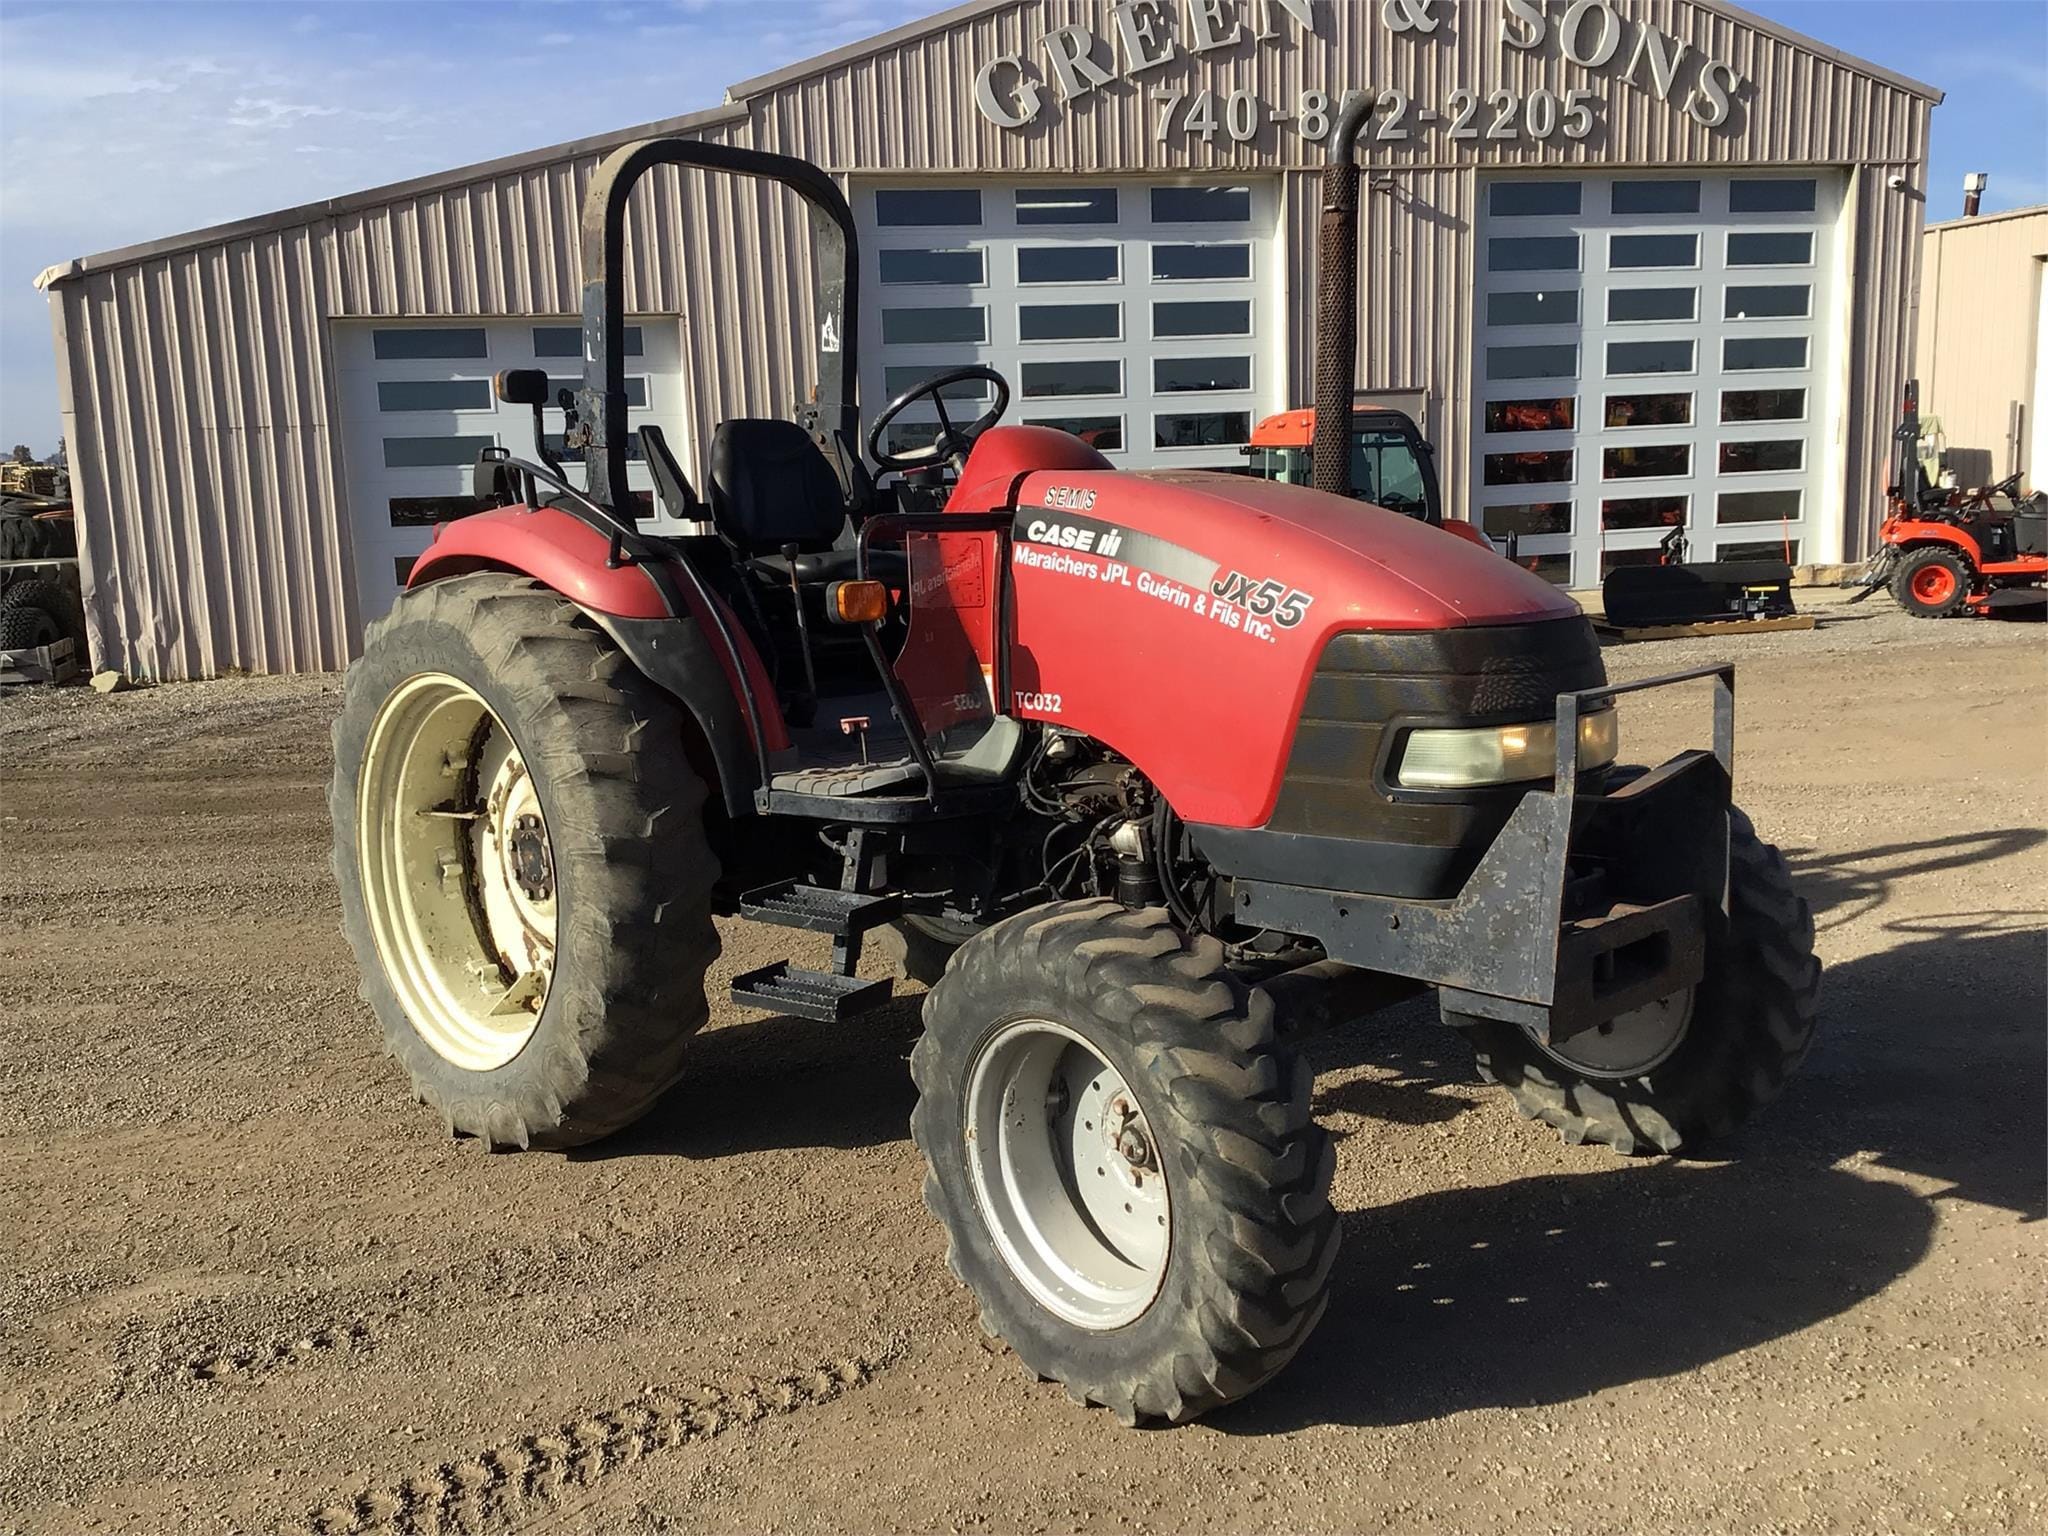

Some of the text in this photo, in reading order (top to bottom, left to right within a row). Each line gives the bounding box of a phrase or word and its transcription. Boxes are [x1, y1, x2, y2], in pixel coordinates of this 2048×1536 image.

[1500, 0, 1745, 128] SONS
[1151, 87, 1594, 141] 740-82-2205
[1045, 486, 1096, 511] SEMIS
[1027, 520, 1096, 552] CASE
[1014, 545, 1277, 644] Maraîchers JPL Guérin & Fils Inc.
[1211, 570, 1314, 628] JX55
[1015, 691, 1062, 713] TC032
